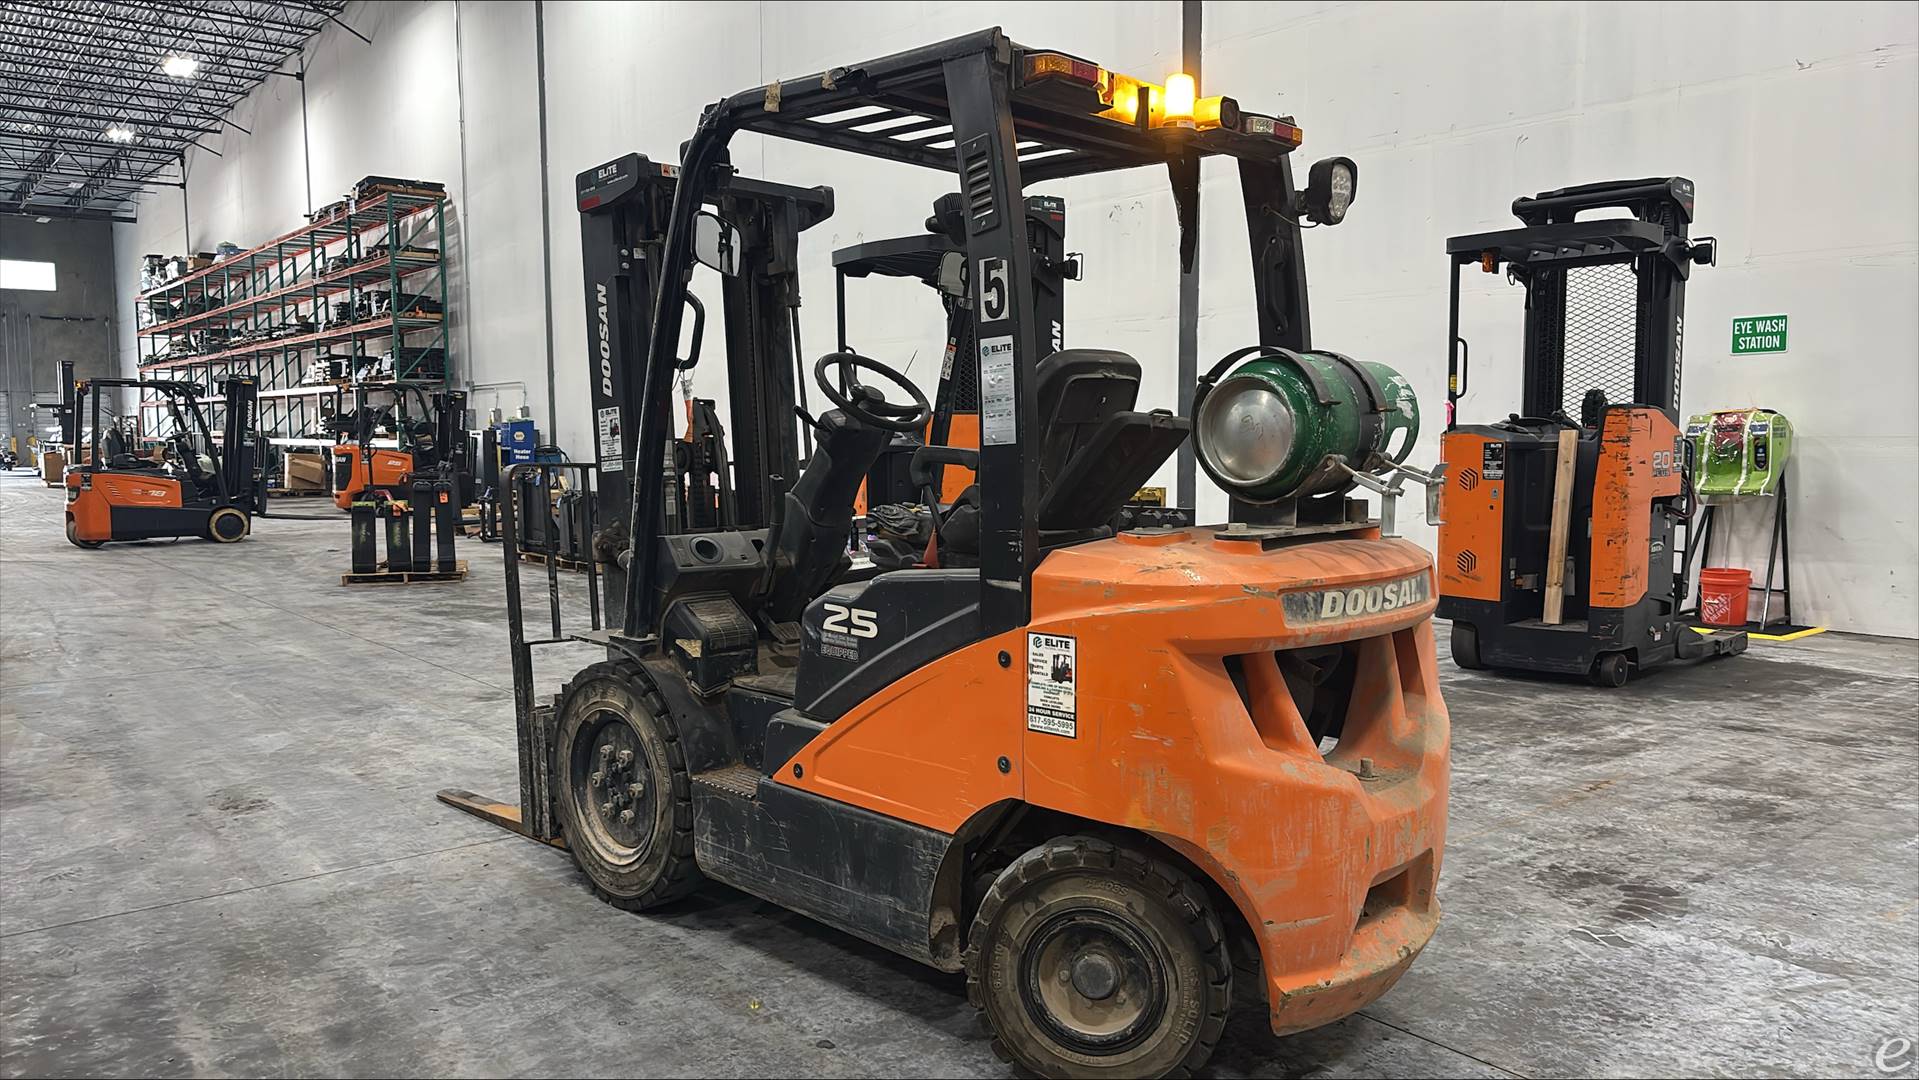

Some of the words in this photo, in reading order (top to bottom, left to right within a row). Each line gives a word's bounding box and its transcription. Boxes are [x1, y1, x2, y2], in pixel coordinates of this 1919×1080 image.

[598, 164, 617, 179] ELITE
[984, 259, 1006, 319] 5
[1734, 321, 1753, 335] EYE
[1755, 318, 1786, 333] WASH
[596, 283, 613, 398] DOOSAN
[991, 343, 1012, 353] ELITE
[1738, 335, 1780, 350] STATION
[1673, 315, 1683, 411] DOOSAN
[1653, 451, 1671, 469] 20
[823, 603, 878, 639] 25
[1044, 637, 1070, 650] ELITE
[1036, 708, 1051, 716] HOUR
[1052, 710, 1075, 720] SERVICE
